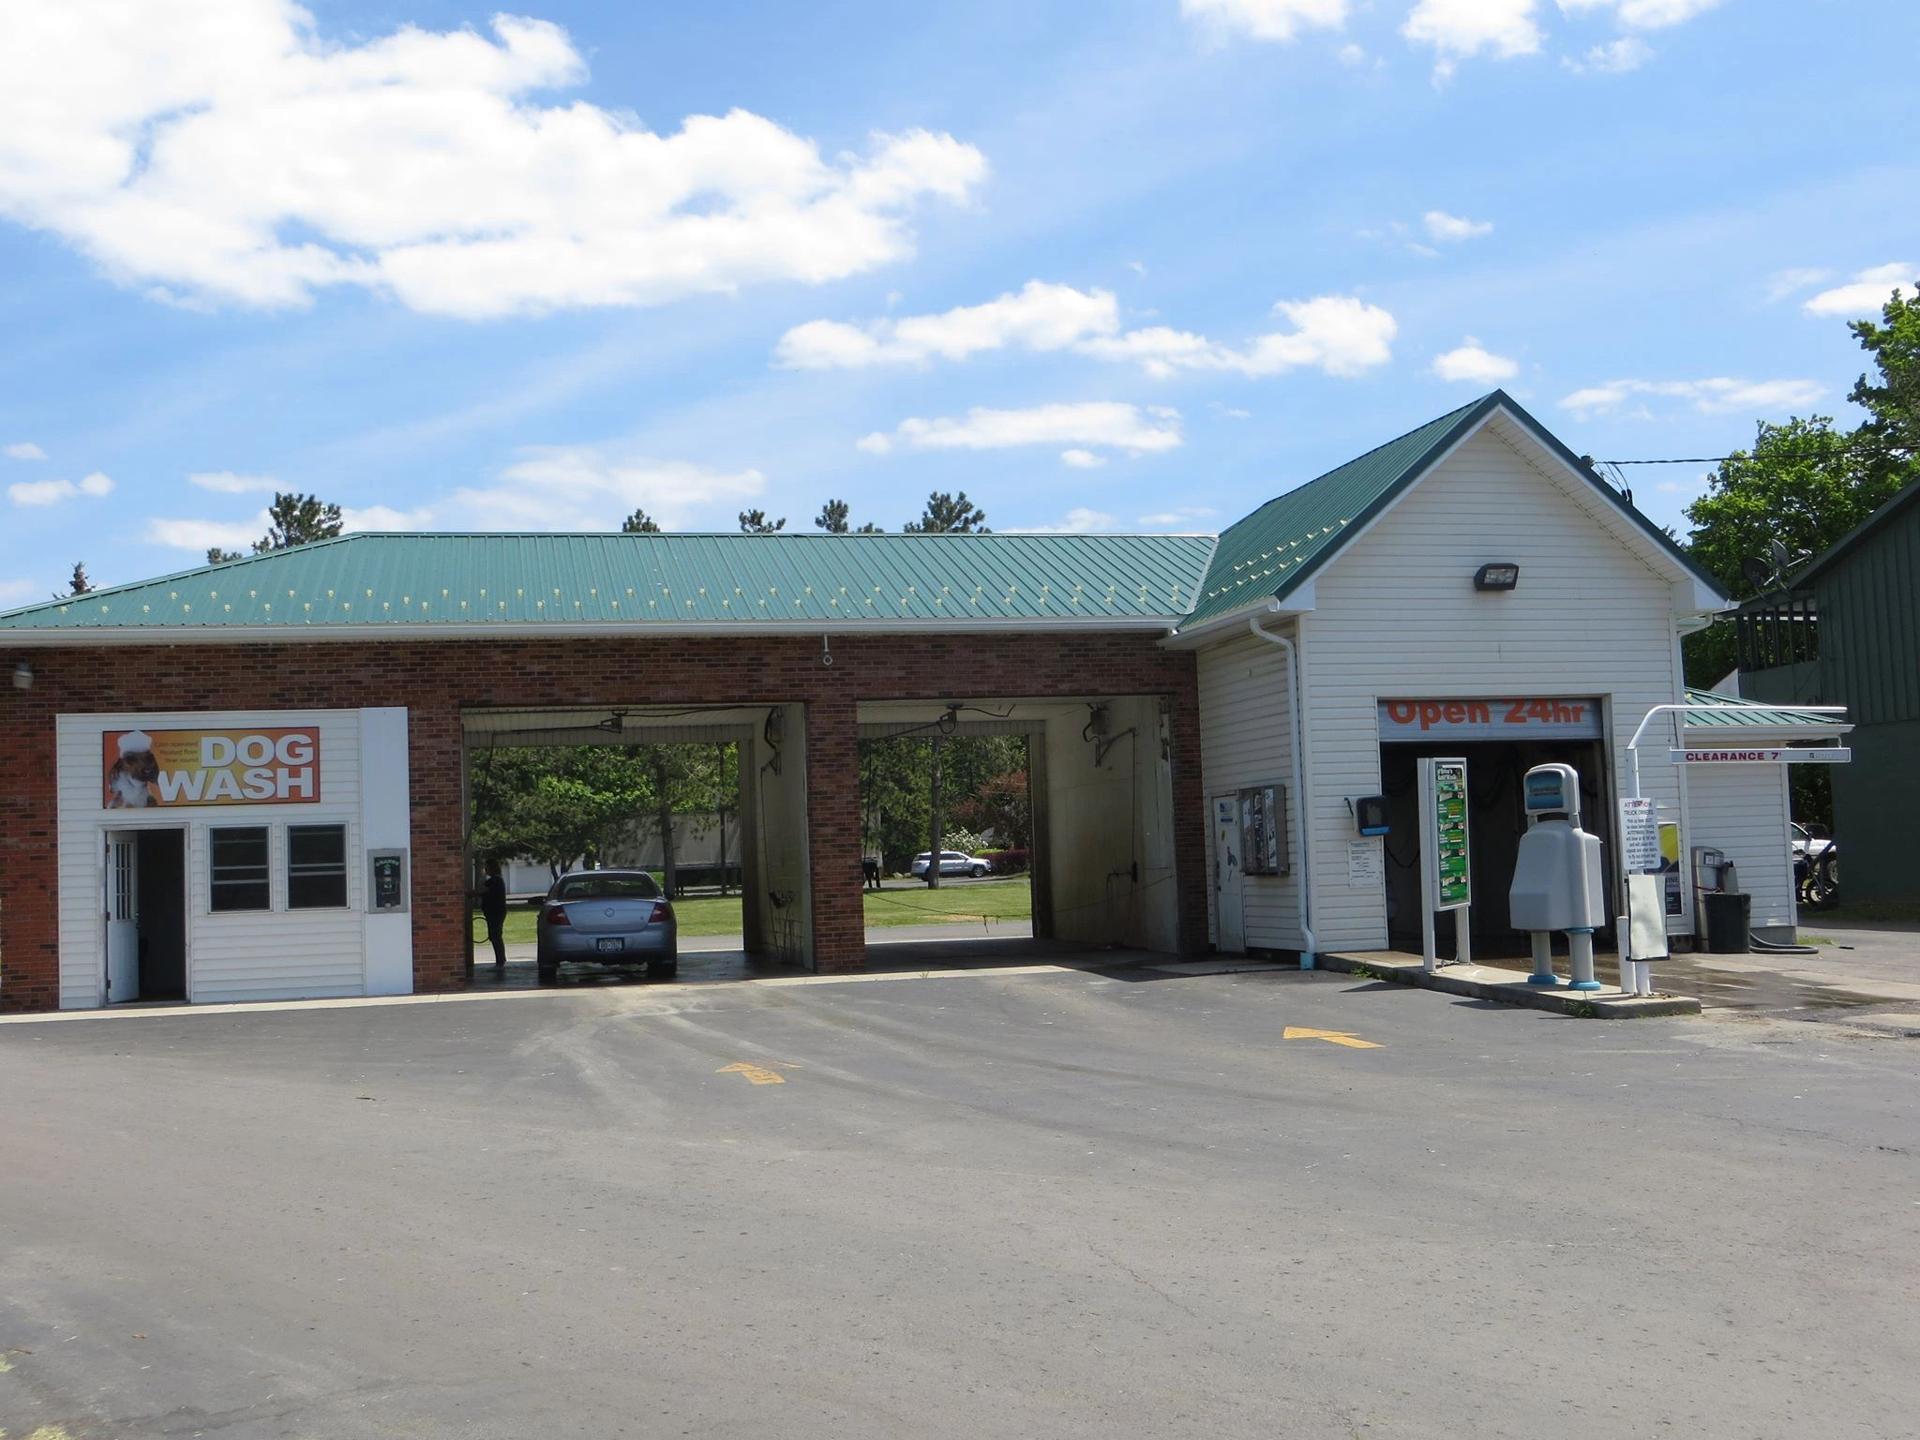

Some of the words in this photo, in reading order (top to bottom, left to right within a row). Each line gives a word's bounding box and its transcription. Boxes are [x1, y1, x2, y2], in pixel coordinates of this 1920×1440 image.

[1387, 699, 1490, 731] Open
[1503, 697, 1585, 724] 24hr
[201, 734, 314, 768] DOG
[1685, 751, 1765, 762] CLEARANCE
[157, 767, 313, 802] WASH
